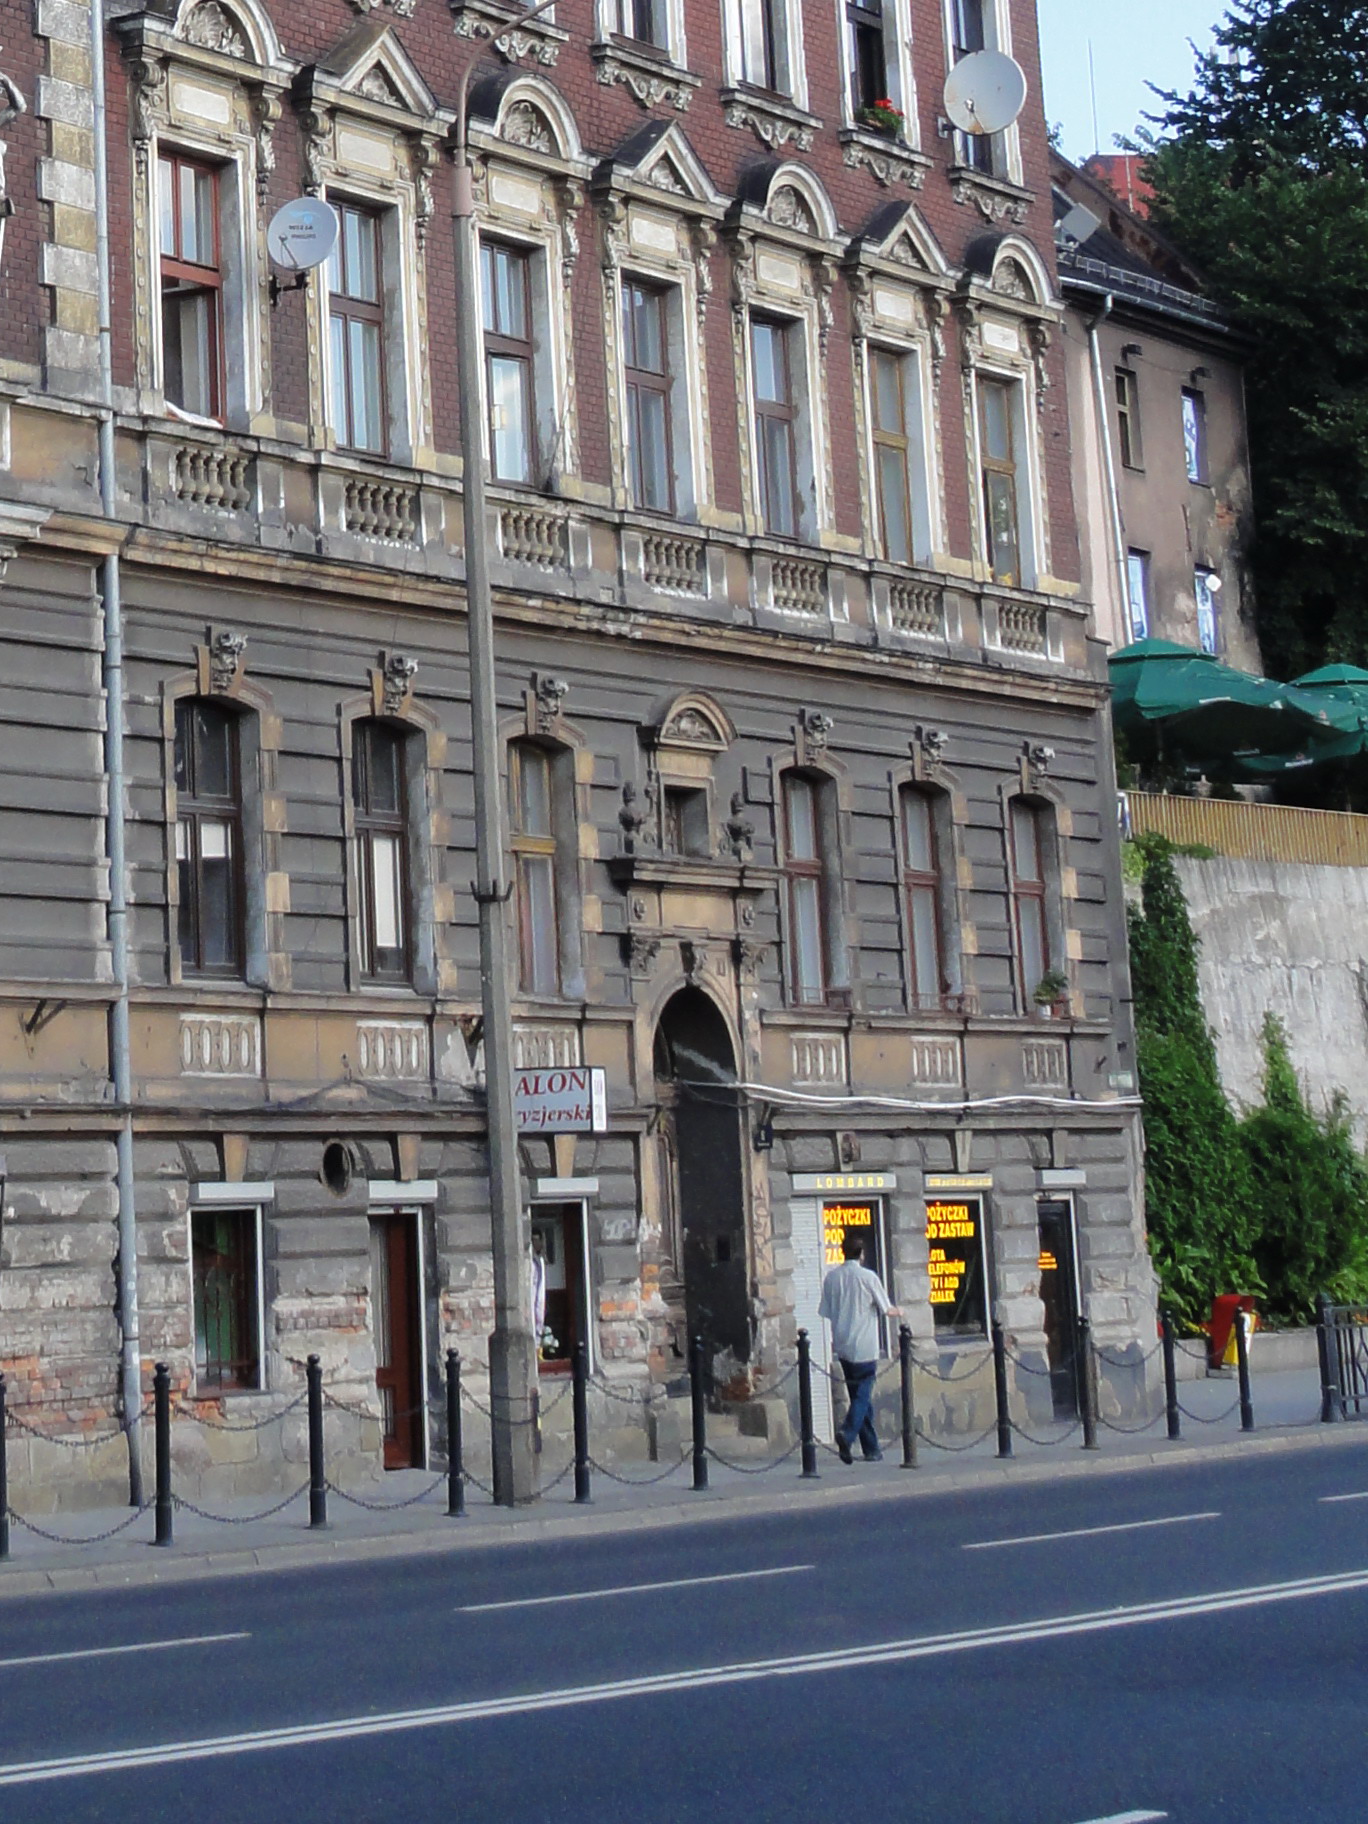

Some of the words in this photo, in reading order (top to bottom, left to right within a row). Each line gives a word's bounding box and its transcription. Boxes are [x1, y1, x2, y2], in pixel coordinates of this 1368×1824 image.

[515, 1070, 587, 1097] ALON
[816, 1176, 885, 1189] LOMBARD
[822, 1205, 871, 1226] POŻYCZKI
[823, 1228, 845, 1245] POD
[938, 1222, 974, 1238] ZASTAW
[928, 1259, 965, 1275] ELEFONÓW
